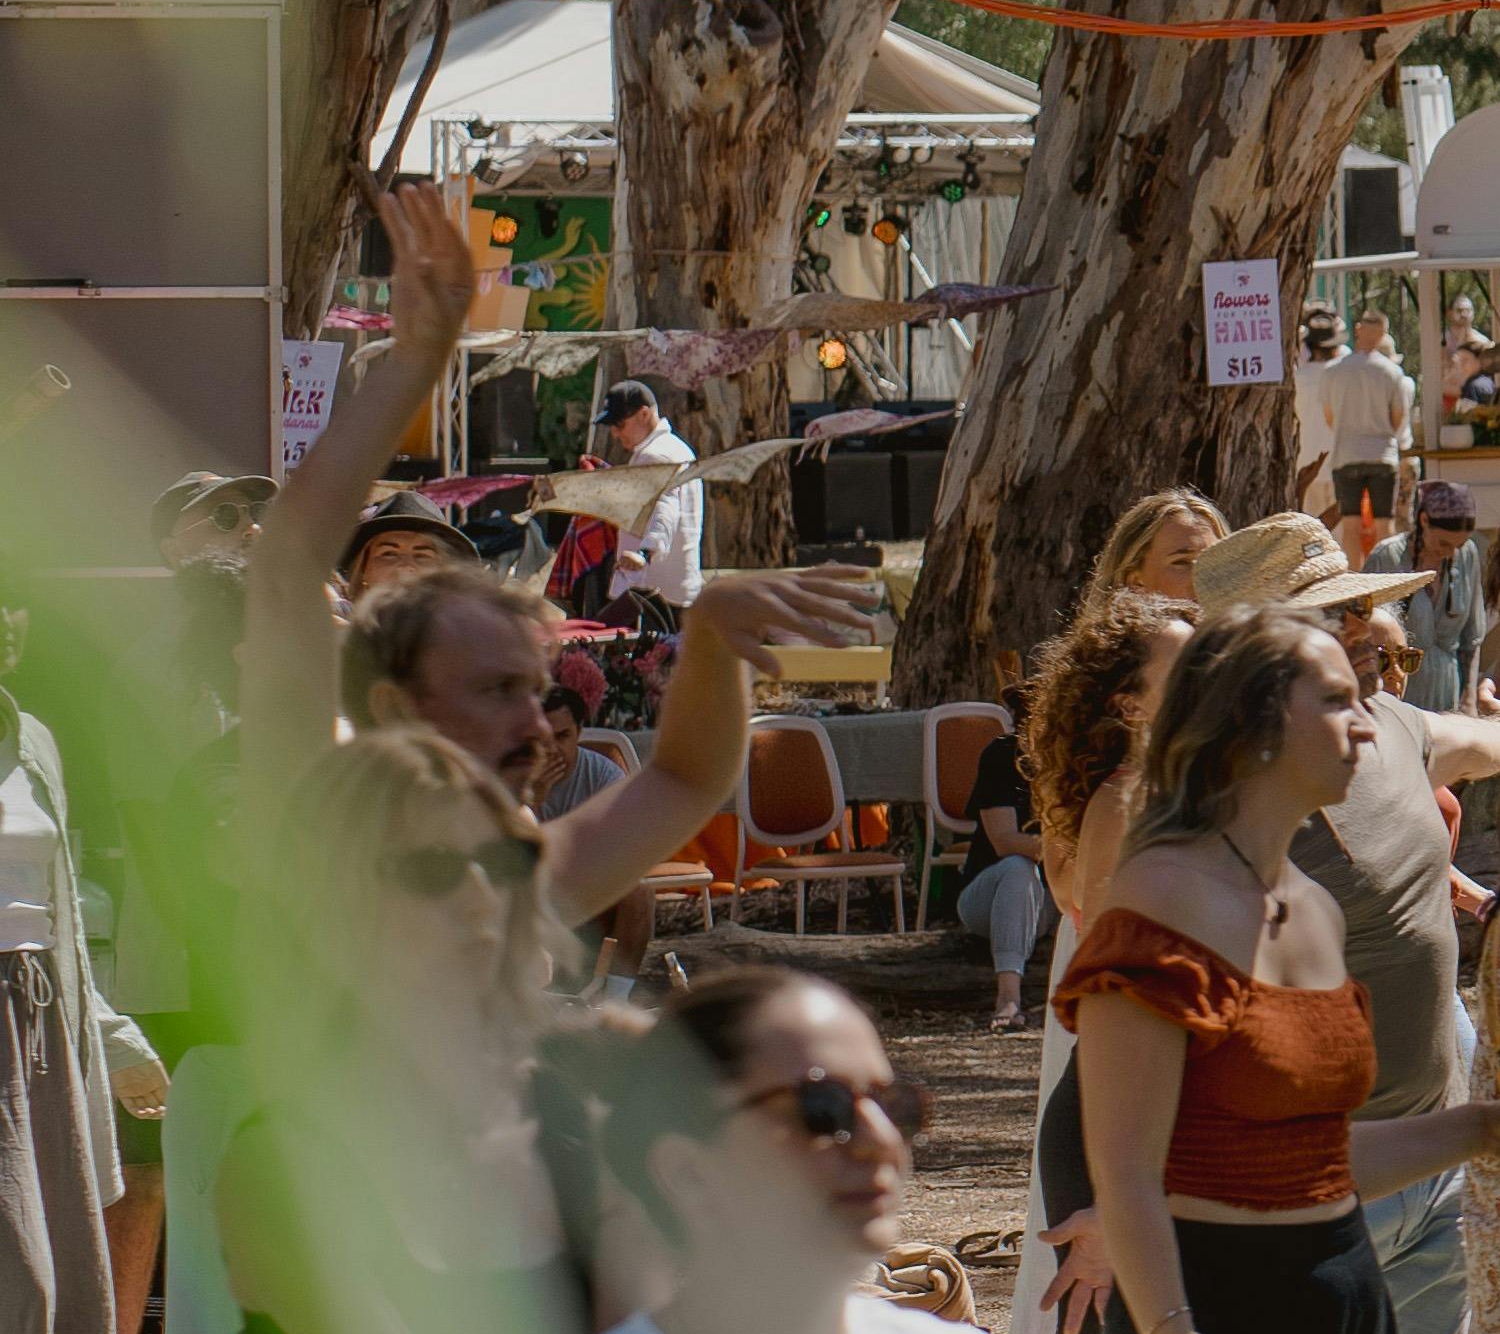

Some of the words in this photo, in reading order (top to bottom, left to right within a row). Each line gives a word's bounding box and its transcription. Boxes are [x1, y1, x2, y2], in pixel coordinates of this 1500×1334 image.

[1213, 290, 1272, 309] flowers
[1216, 311, 1236, 319] FOR
[1243, 309, 1269, 317] YOUR
[1214, 319, 1274, 344] HAIR
[1227, 355, 1263, 379] $15
